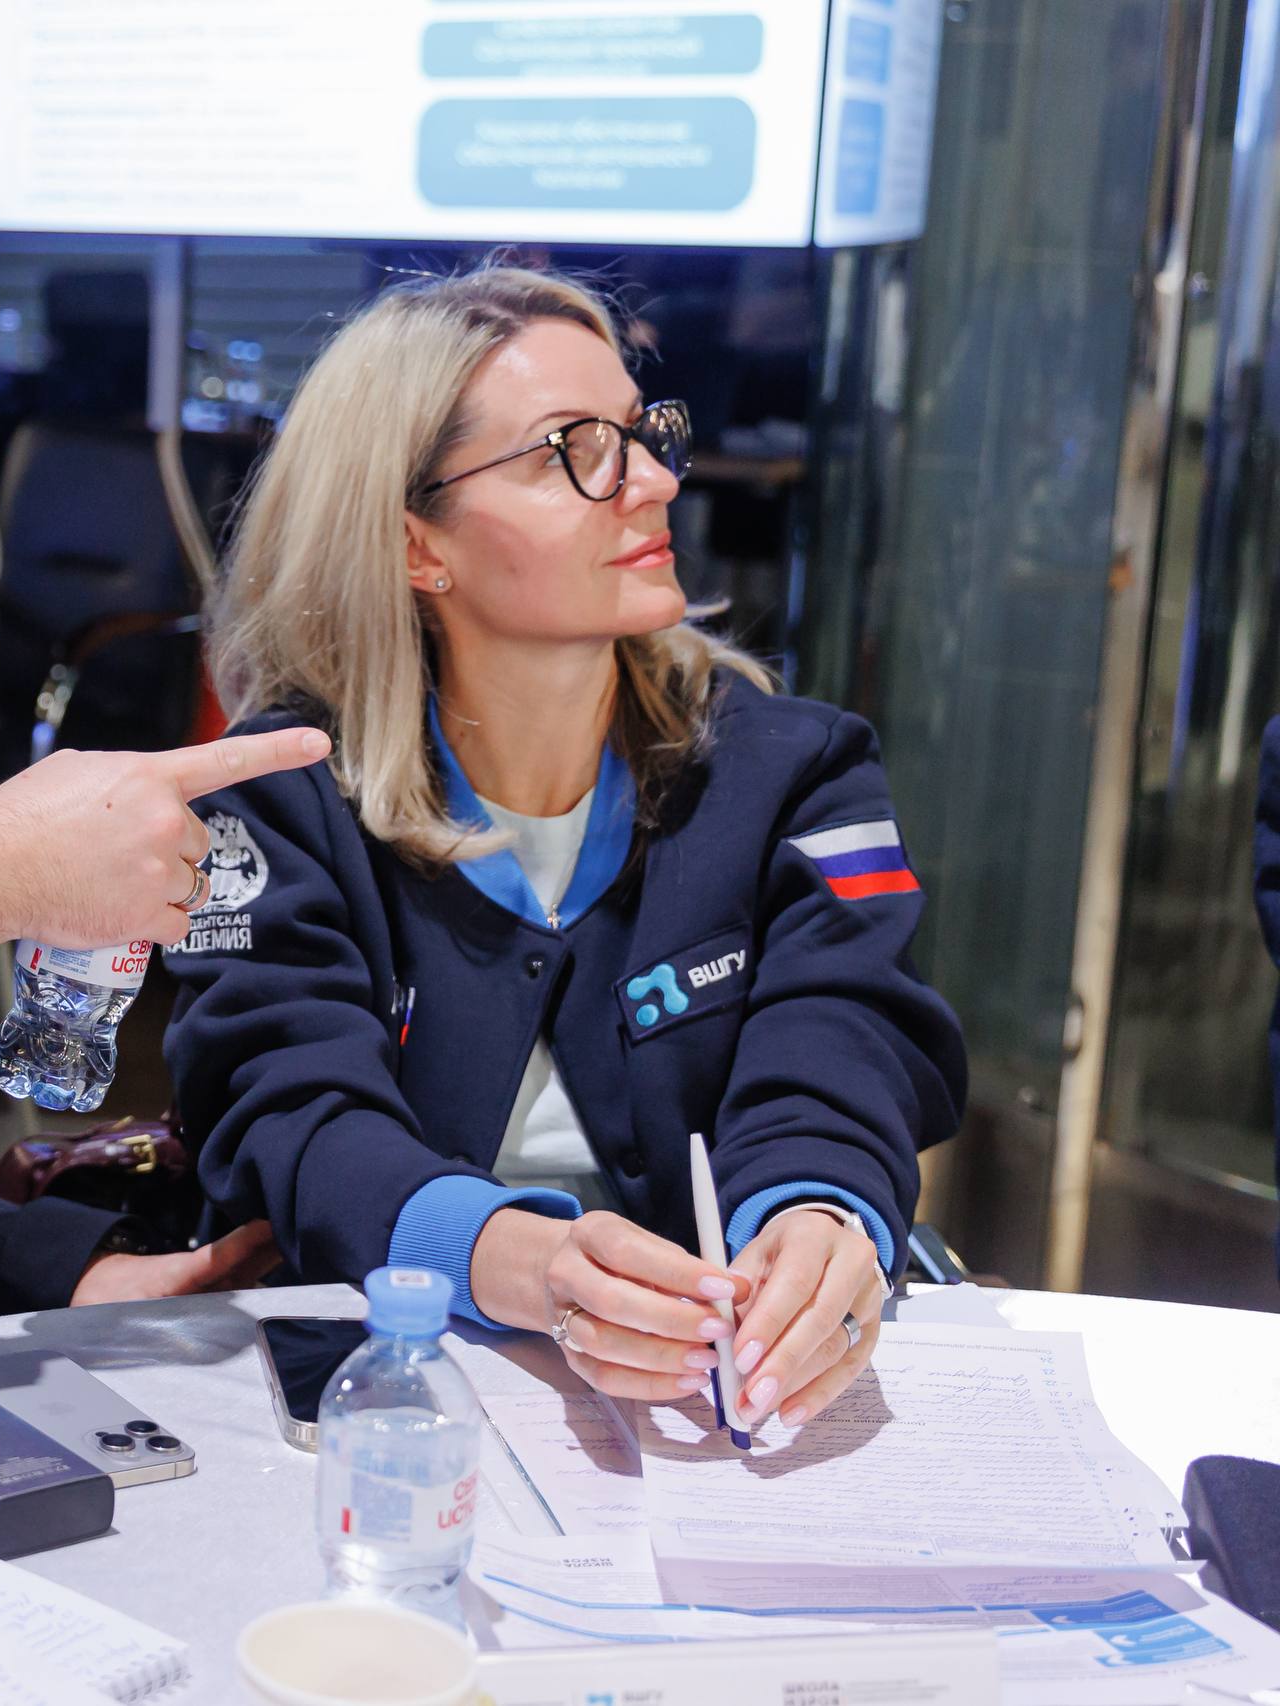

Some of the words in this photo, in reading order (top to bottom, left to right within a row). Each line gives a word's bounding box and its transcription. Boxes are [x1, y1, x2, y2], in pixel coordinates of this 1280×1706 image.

[190, 913, 251, 930] ДЕНТСКАЯ
[164, 927, 253, 954] АДЕМИЯ
[687, 949, 747, 989] ВШГУ
